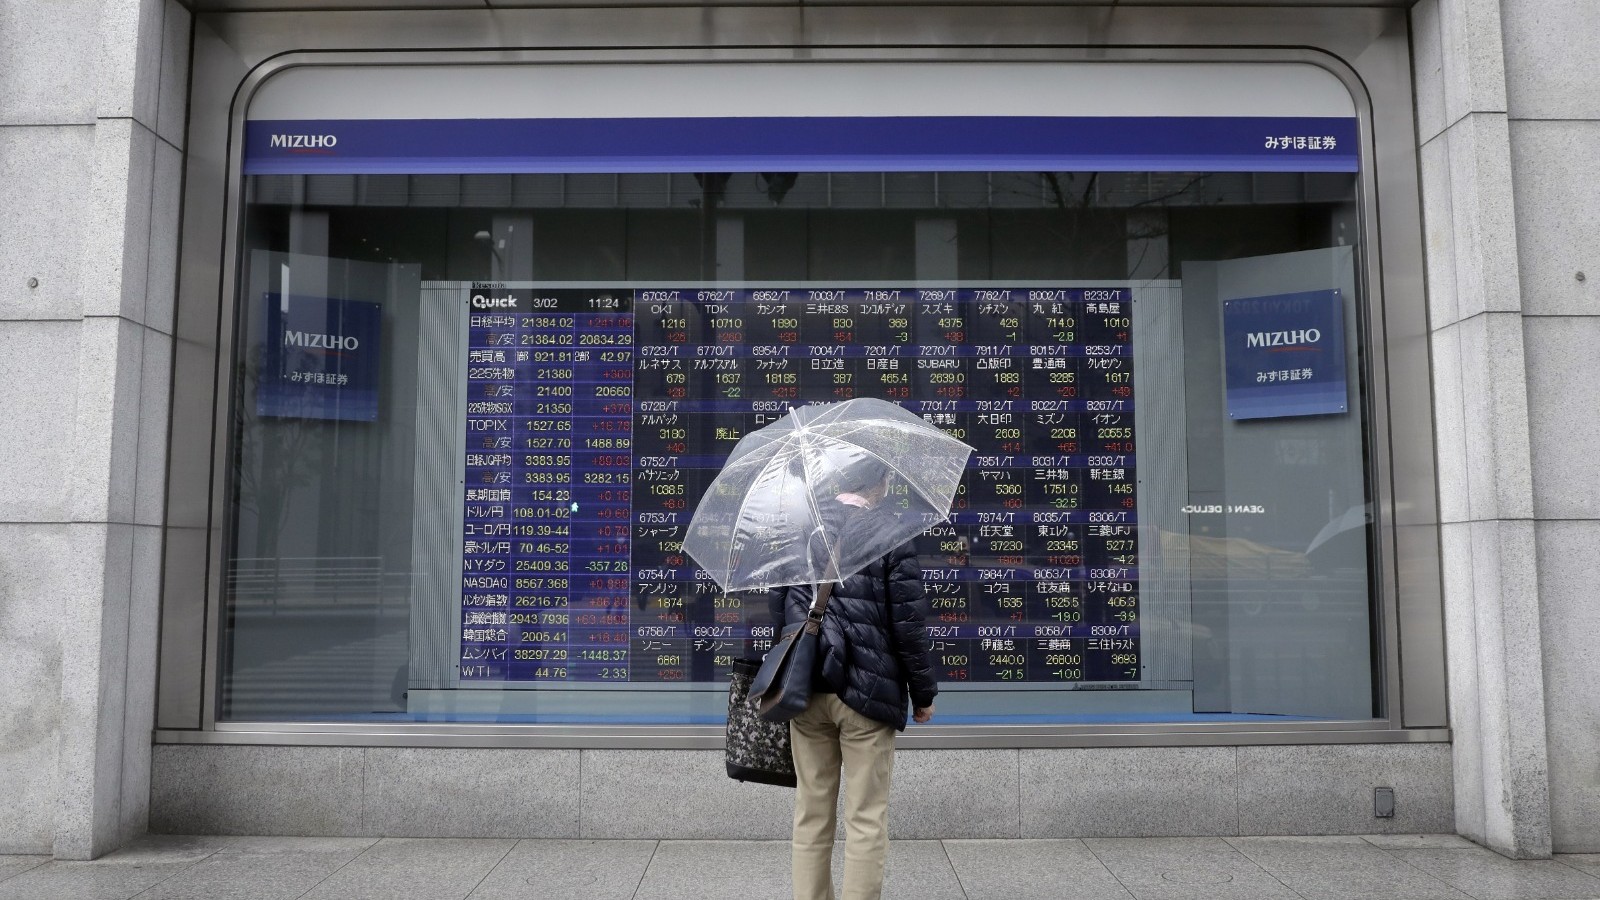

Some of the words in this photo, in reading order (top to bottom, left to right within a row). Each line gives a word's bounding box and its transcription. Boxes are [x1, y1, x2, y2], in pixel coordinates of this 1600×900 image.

[271, 135, 337, 147] MIZUHO
[1265, 136, 1336, 149] みずほ証券
[643, 291, 680, 300] 6703/T
[698, 291, 735, 300] 6762/T
[753, 291, 790, 300] 6952/T
[808, 291, 845, 300] 7003/T
[864, 291, 900, 300] 7186/T
[919, 291, 956, 300] 7269/T
[974, 291, 1011, 300] 7762/T
[1029, 291, 1066, 300] 8002/T
[1084, 291, 1121, 300] 8233/T
[473, 295, 517, 308] Quick
[534, 298, 557, 308] 3/02
[589, 298, 619, 307] 11:24
[651, 305, 672, 313] OKI
[705, 305, 728, 313] TDK
[757, 304, 786, 314] カシオ
[806, 304, 848, 314] 三井E&S
[922, 304, 953, 314] スズキ
[979, 304, 1008, 314] シチズン
[1086, 304, 1120, 313] 高島屋
[471, 316, 515, 328] 日経平均
[522, 318, 573, 327] 21384.02
[661, 319, 685, 329] 1216
[710, 319, 742, 328] 10710
[772, 319, 797, 328] 1890
[833, 319, 852, 328] 830
[938, 318, 962, 327] 4375
[1000, 318, 1018, 327] 426
[1047, 318, 1074, 327] 714.0
[1104, 318, 1129, 327] 1010
[285, 331, 358, 350] MIZUHO
[521, 335, 573, 344] 21384.02
[580, 335, 631, 344] 20834.29
[896, 332, 907, 341] -3
[1006, 332, 1015, 341] -1
[1247, 329, 1320, 348] MIZUHO
[642, 346, 679, 356] 6723/T
[697, 346, 734, 356] 6770/T
[753, 346, 790, 356] 6954/T
[809, 346, 845, 355] 7004/T
[864, 346, 901, 355] 7201/T
[920, 346, 956, 355] 7270/T
[975, 346, 1012, 355] 7911/T
[1031, 346, 1067, 355] 8015/T
[1086, 346, 1122, 355] 8253/T
[470, 351, 505, 362] 売買高
[535, 352, 572, 361] 921.81
[601, 352, 630, 361] 42.97
[639, 359, 681, 369] ルネサス
[811, 359, 844, 369] 日立造
[867, 359, 898, 369] 日産自
[918, 360, 959, 368] SUBARU
[977, 359, 1011, 369] 凸版印
[1033, 359, 1066, 369] 豊通商
[470, 368, 514, 379] 225先物
[538, 369, 572, 378] 21380
[1105, 373, 1130, 382] 1617
[1257, 368, 1312, 382] みずほ証券
[292, 372, 348, 385] みずほ証券
[667, 374, 684, 383] 679
[716, 374, 740, 383] 1637
[881, 374, 907, 383] 465.4
[930, 374, 964, 383] 2639.0
[537, 387, 571, 396] 21400
[596, 387, 630, 396] 20660
[722, 388, 740, 397] -22
[537, 404, 571, 413] 21350
[641, 402, 678, 411] 6728/T
[753, 401, 790, 411] 6963/T
[920, 401, 957, 410] 7701/T
[976, 401, 1013, 410] 7912/T
[1032, 401, 1068, 410] 8022/T
[1087, 401, 1124, 410] 8267/T
[978, 414, 1011, 424] 大日印
[1037, 414, 1064, 424] ミズノ
[1092, 414, 1121, 424] イオン
[469, 420, 506, 430] TOPIX
[527, 421, 571, 430] 1527.65
[660, 429, 685, 438] 3180
[716, 428, 740, 439] 廃止
[996, 429, 1020, 438] 2609
[527, 438, 570, 448] 1527.70
[585, 439, 629, 448] 1488.89
[467, 455, 511, 466] 日経JQ平均
[526, 456, 570, 465] 3383.95
[640, 457, 678, 466] 6752/T
[977, 457, 1014, 466] 7951/T
[1088, 456, 1125, 466] 8303/T
[526, 473, 569, 482] 3383.95
[584, 474, 629, 483] 3282.15
[979, 470, 1010, 480] ヤマハ
[1035, 469, 1069, 480] 三井物
[1090, 469, 1125, 480] 新生銀
[996, 485, 1022, 494] 5360
[1044, 485, 1078, 494] 1751.0
[1108, 485, 1132, 493] 1445
[467, 490, 510, 501] 長期国債
[532, 491, 569, 500] 154.23
[467, 506, 503, 517] ドル/円
[514, 508, 569, 518] 108.01-02
[640, 513, 677, 523] 6753/T
[977, 513, 1015, 522] 7974/T
[465, 524, 510, 535] ユーロ/円
[514, 526, 569, 535] 119.39-44
[639, 526, 678, 536] シャープ
[924, 528, 956, 536] HOYA
[979, 526, 1013, 536] 任天堂
[1088, 526, 1130, 535] 三菱UFJ
[520, 543, 568, 553] 70.46-52
[991, 541, 1022, 550] 37230
[1047, 541, 1078, 550] 23345
[1107, 541, 1133, 550] 527.7
[516, 561, 568, 570] 25409.36
[586, 562, 627, 571] -357.28
[639, 570, 676, 580] 6754/T
[922, 570, 959, 579] 7751/T
[464, 578, 507, 588] NASDAQ
[516, 579, 568, 588] 8567.368
[1088, 582, 1132, 592] りそなHD
[639, 584, 676, 594] アンリツ
[984, 583, 1009, 593] コクヨ
[1036, 583, 1070, 593] 住友商
[516, 597, 568, 606] 26216.73
[658, 599, 682, 607] 1874
[714, 599, 740, 607] 5170
[932, 598, 965, 608] 2767.5
[998, 598, 1022, 607] 1535
[1045, 598, 1079, 607] 1525.5
[463, 629, 508, 642] 韓国総合
[522, 632, 567, 641] 2005.41
[695, 627, 732, 636] 6902/T
[979, 627, 1016, 636] 8001/T
[642, 640, 671, 651] ソニー
[694, 639, 733, 651] デンソー
[980, 640, 1015, 650] 伊藤忠
[1037, 640, 1070, 650] 三菱商
[463, 648, 508, 660] ムンバイ
[515, 650, 567, 659] 38297.29
[577, 650, 626, 660] -1448.37
[942, 656, 967, 665] 1020
[990, 655, 1024, 665] 2440.0
[1112, 655, 1136, 664] 3693
[535, 668, 567, 677] 44.76
[598, 668, 627, 678] -2.33
